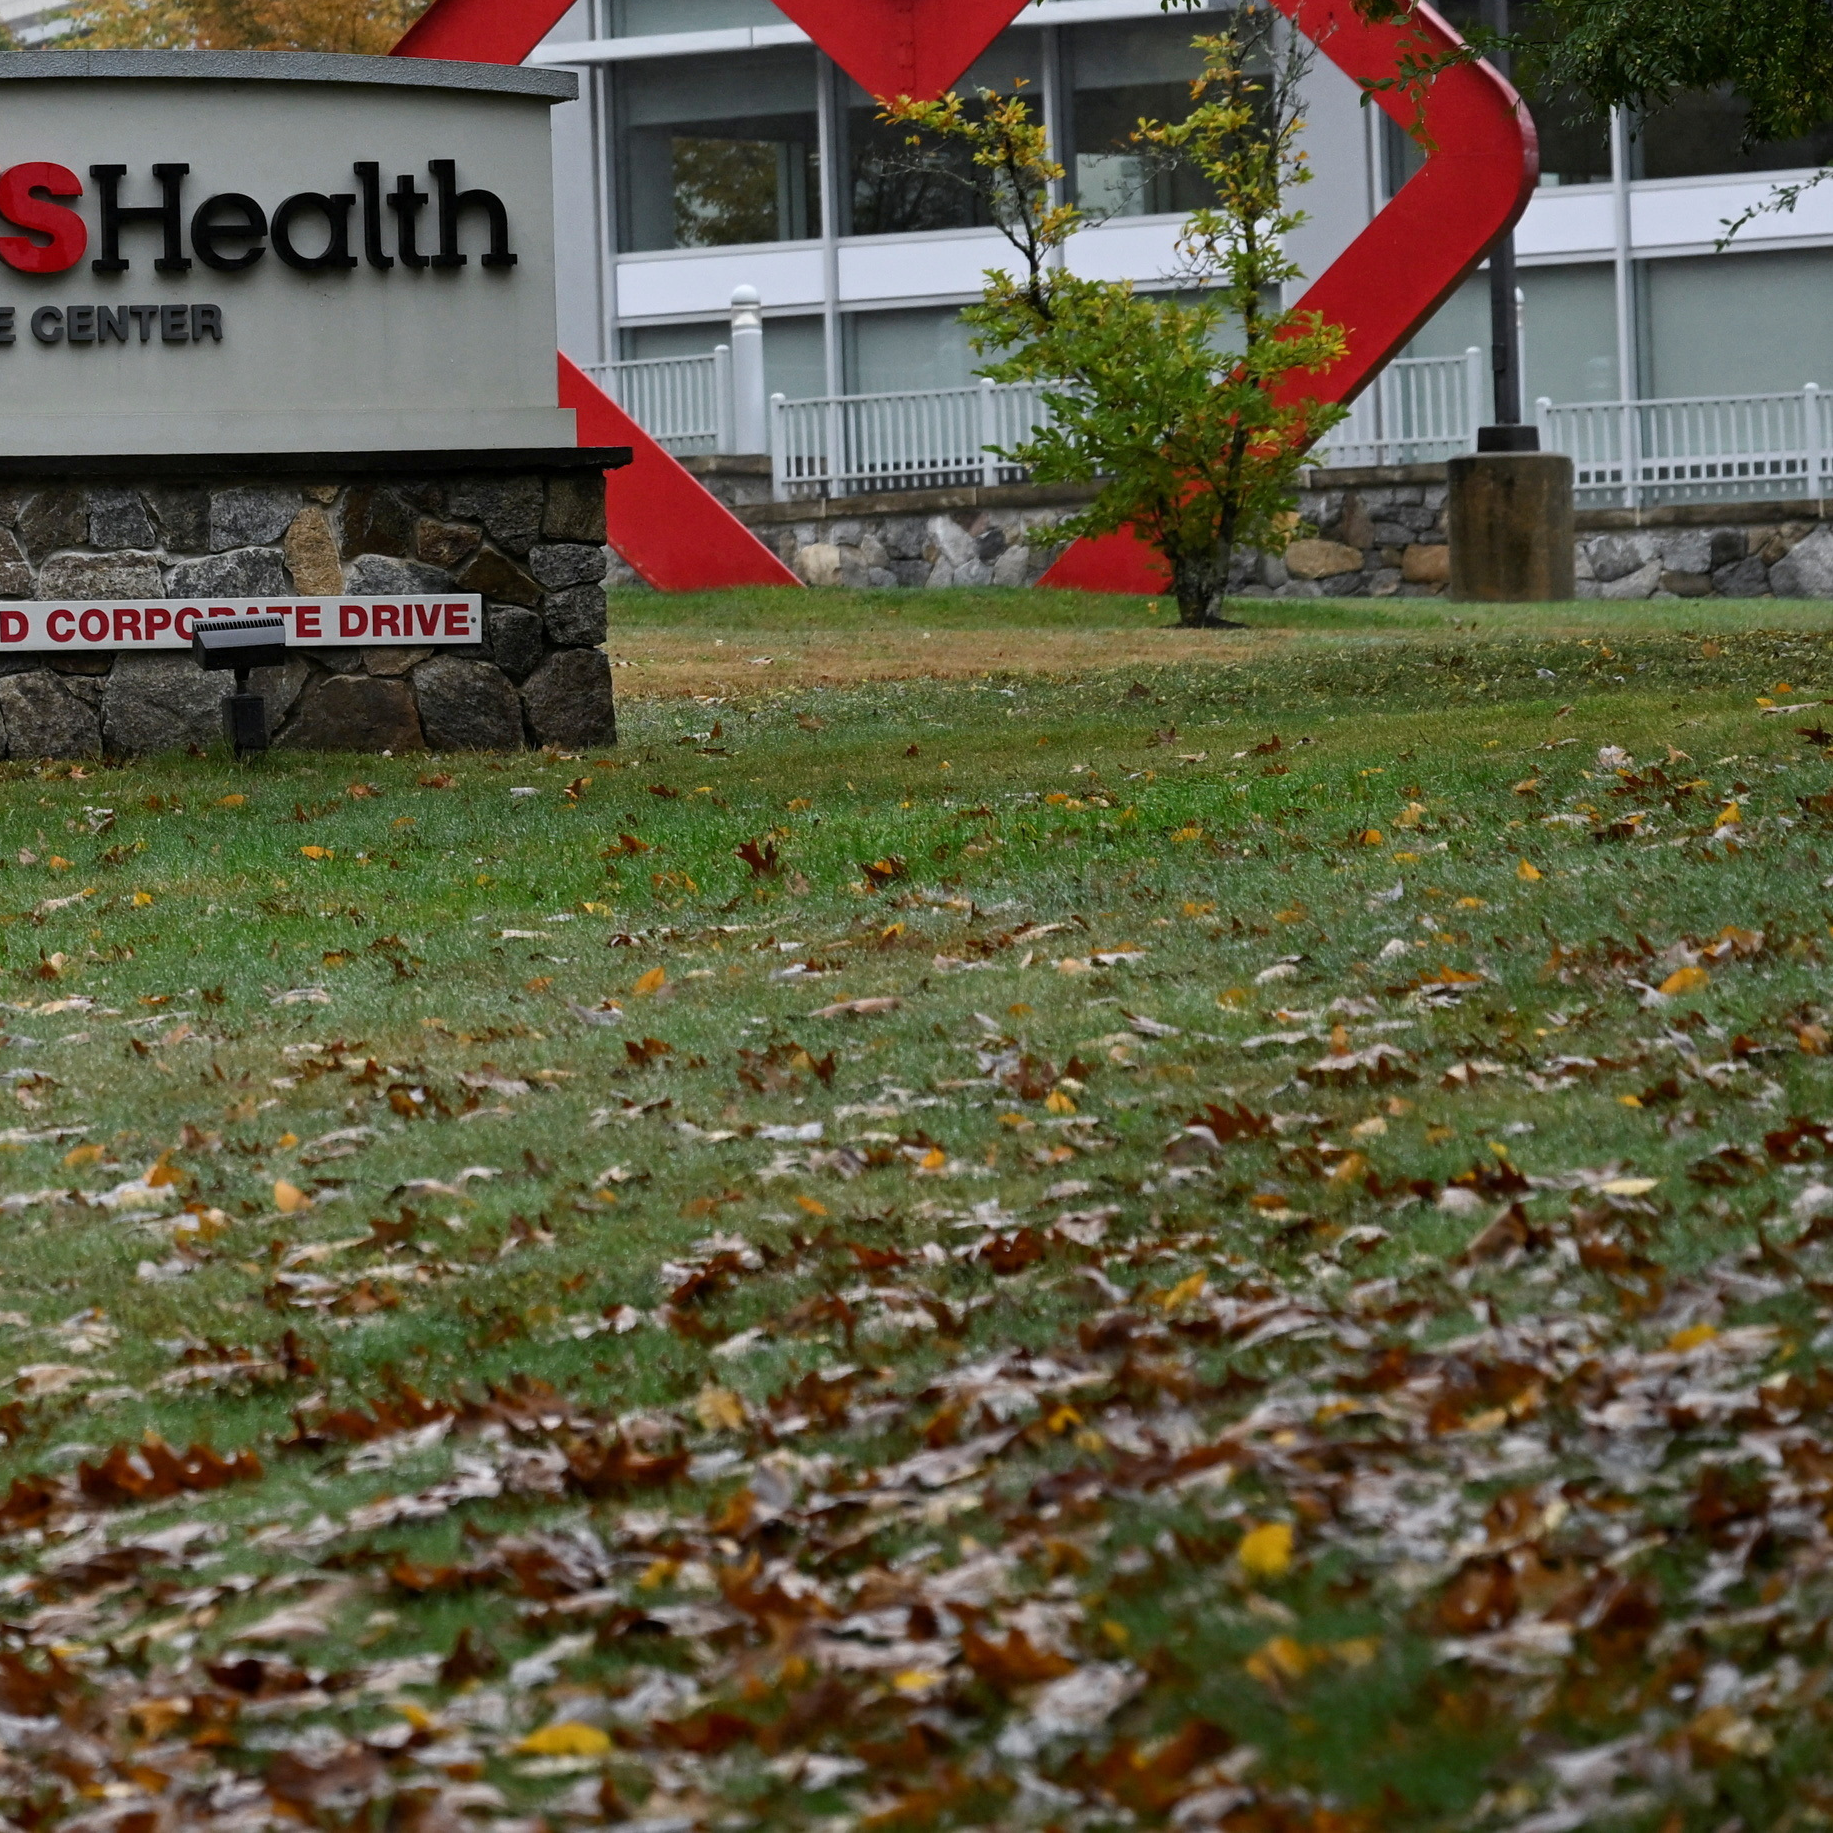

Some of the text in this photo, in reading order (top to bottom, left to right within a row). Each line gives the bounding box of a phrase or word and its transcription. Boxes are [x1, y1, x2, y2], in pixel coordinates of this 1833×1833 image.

[31, 304, 224, 342] CENTER
[45, 606, 322, 643] CORPOE
[339, 603, 471, 637] DRIVE
